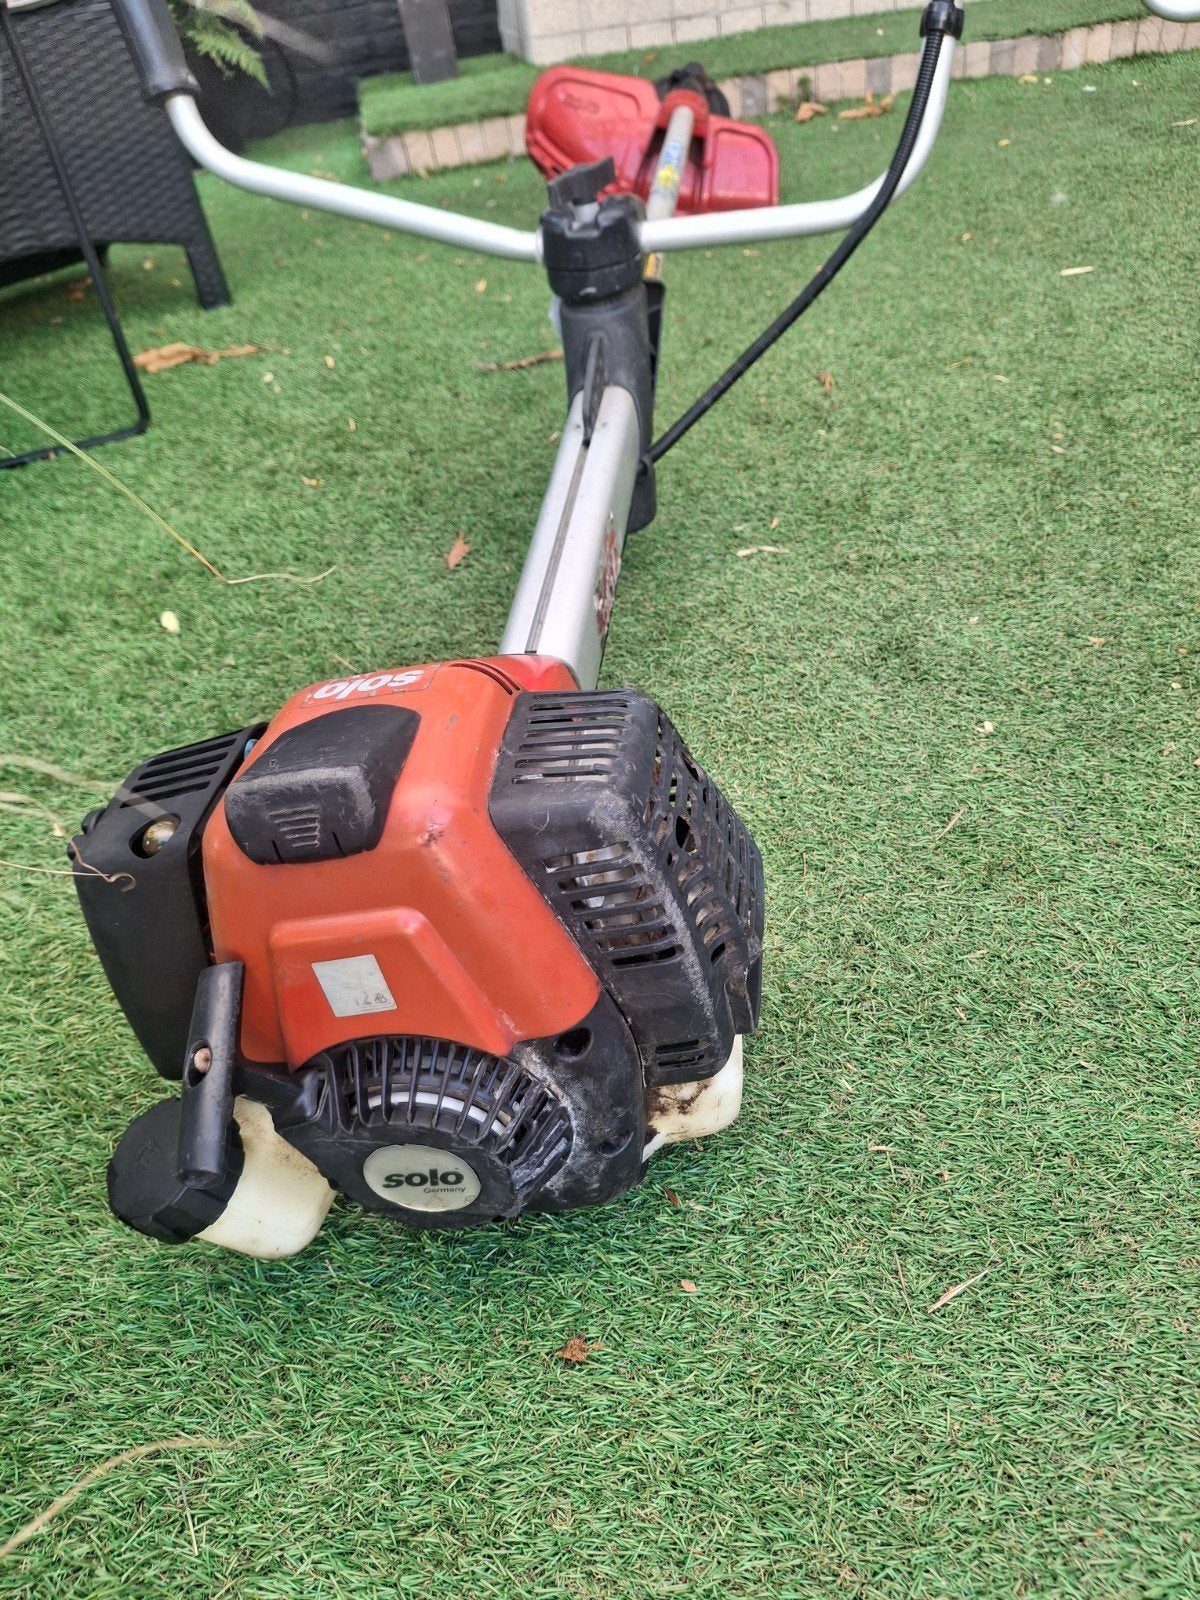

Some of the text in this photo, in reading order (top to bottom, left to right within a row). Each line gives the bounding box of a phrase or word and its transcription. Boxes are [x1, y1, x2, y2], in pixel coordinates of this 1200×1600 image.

[313, 669, 425, 700] solo
[382, 1168, 465, 1188] solo
[423, 1186, 467, 1194] Germany
